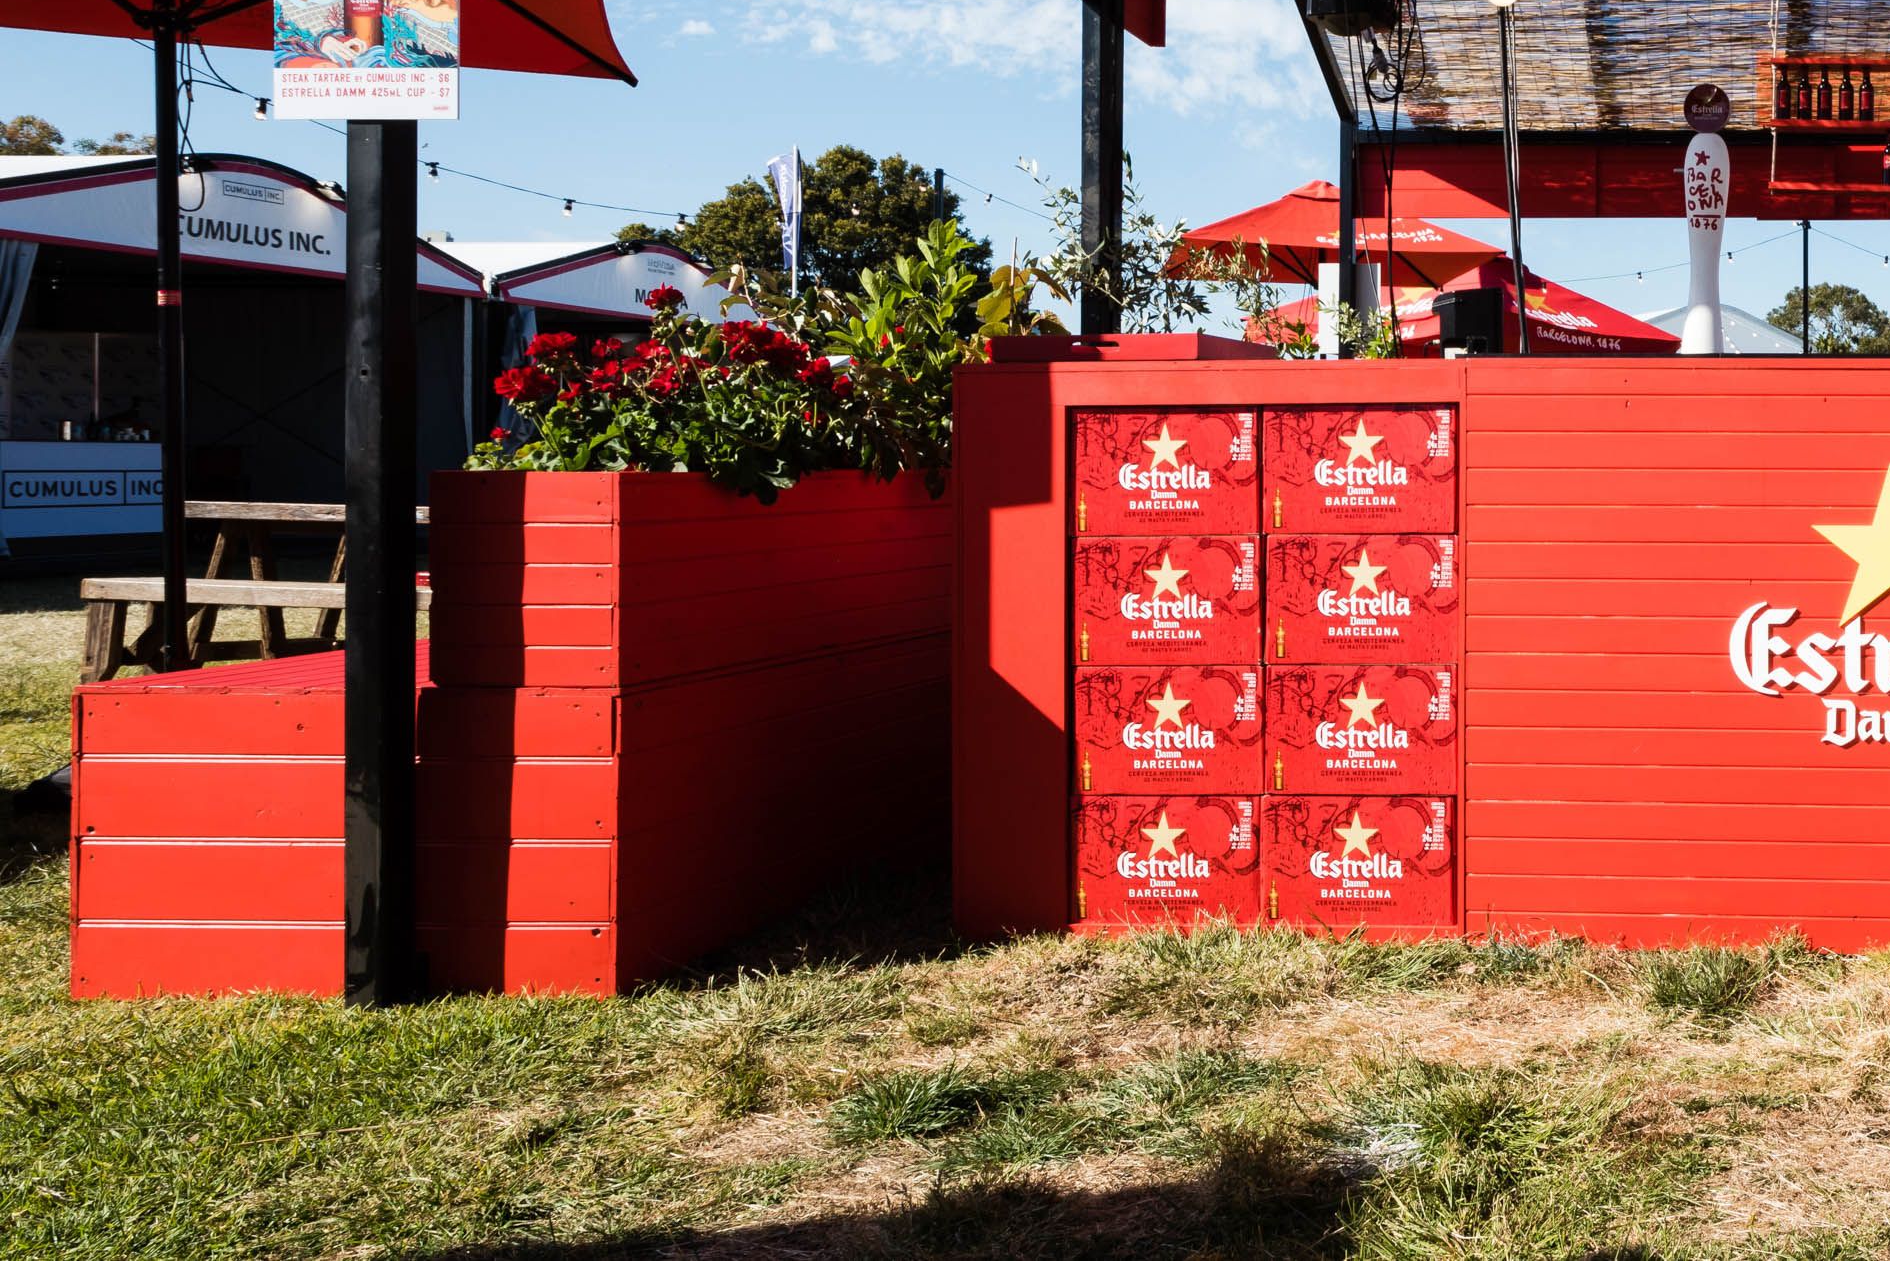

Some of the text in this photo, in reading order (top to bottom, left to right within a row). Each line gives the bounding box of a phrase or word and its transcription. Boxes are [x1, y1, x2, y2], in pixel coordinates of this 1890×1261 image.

[282, 74, 309, 83] STEAK
[314, 74, 350, 83] TARTARE
[367, 74, 406, 83] CUMULUS
[411, 74, 425, 83] INC
[438, 73, 450, 83] $6
[282, 88, 330, 97] ESTRELLA
[337, 88, 365, 97] DAMM
[408, 88, 425, 97] CUP
[440, 88, 450, 97] $7
[1691, 105, 1723, 114] Estrella
[1687, 167, 1723, 184] BAR
[225, 185, 263, 198] CUMULUS
[1690, 218, 1718, 230] 1876
[289, 231, 331, 255] INC.
[1596, 338, 1621, 350] 1876
[1119, 463, 1211, 491] Estrella
[1315, 459, 1408, 487] Estrella
[9, 480, 117, 498] CUMULUS
[1347, 486, 1375, 495] Damm
[1151, 490, 1178, 499] Damm
[1129, 500, 1200, 509] BARCELONA
[1325, 496, 1396, 505] BARCELONA
[1121, 593, 1213, 621] Estrella
[1318, 590, 1411, 618] Estrella
[1153, 620, 1180, 629] Damm
[1350, 617, 1378, 626] Damm
[1131, 630, 1202, 639] BARCELONA
[1328, 627, 1400, 636] BARCELONA
[1123, 722, 1215, 750] Estrella
[1316, 722, 1408, 750] Estrella
[1155, 749, 1182, 758] Damm
[1348, 749, 1375, 758] Damm
[1133, 759, 1204, 768] BARCELONA
[1326, 759, 1397, 768] BARCELONA
[1117, 851, 1209, 879] Estrella
[1310, 852, 1403, 880] Estrella
[1149, 878, 1176, 887] Damm
[1342, 879, 1370, 888] Damm
[1128, 888, 1199, 897] BARCELONA
[1320, 889, 1391, 898] BARCELONA
